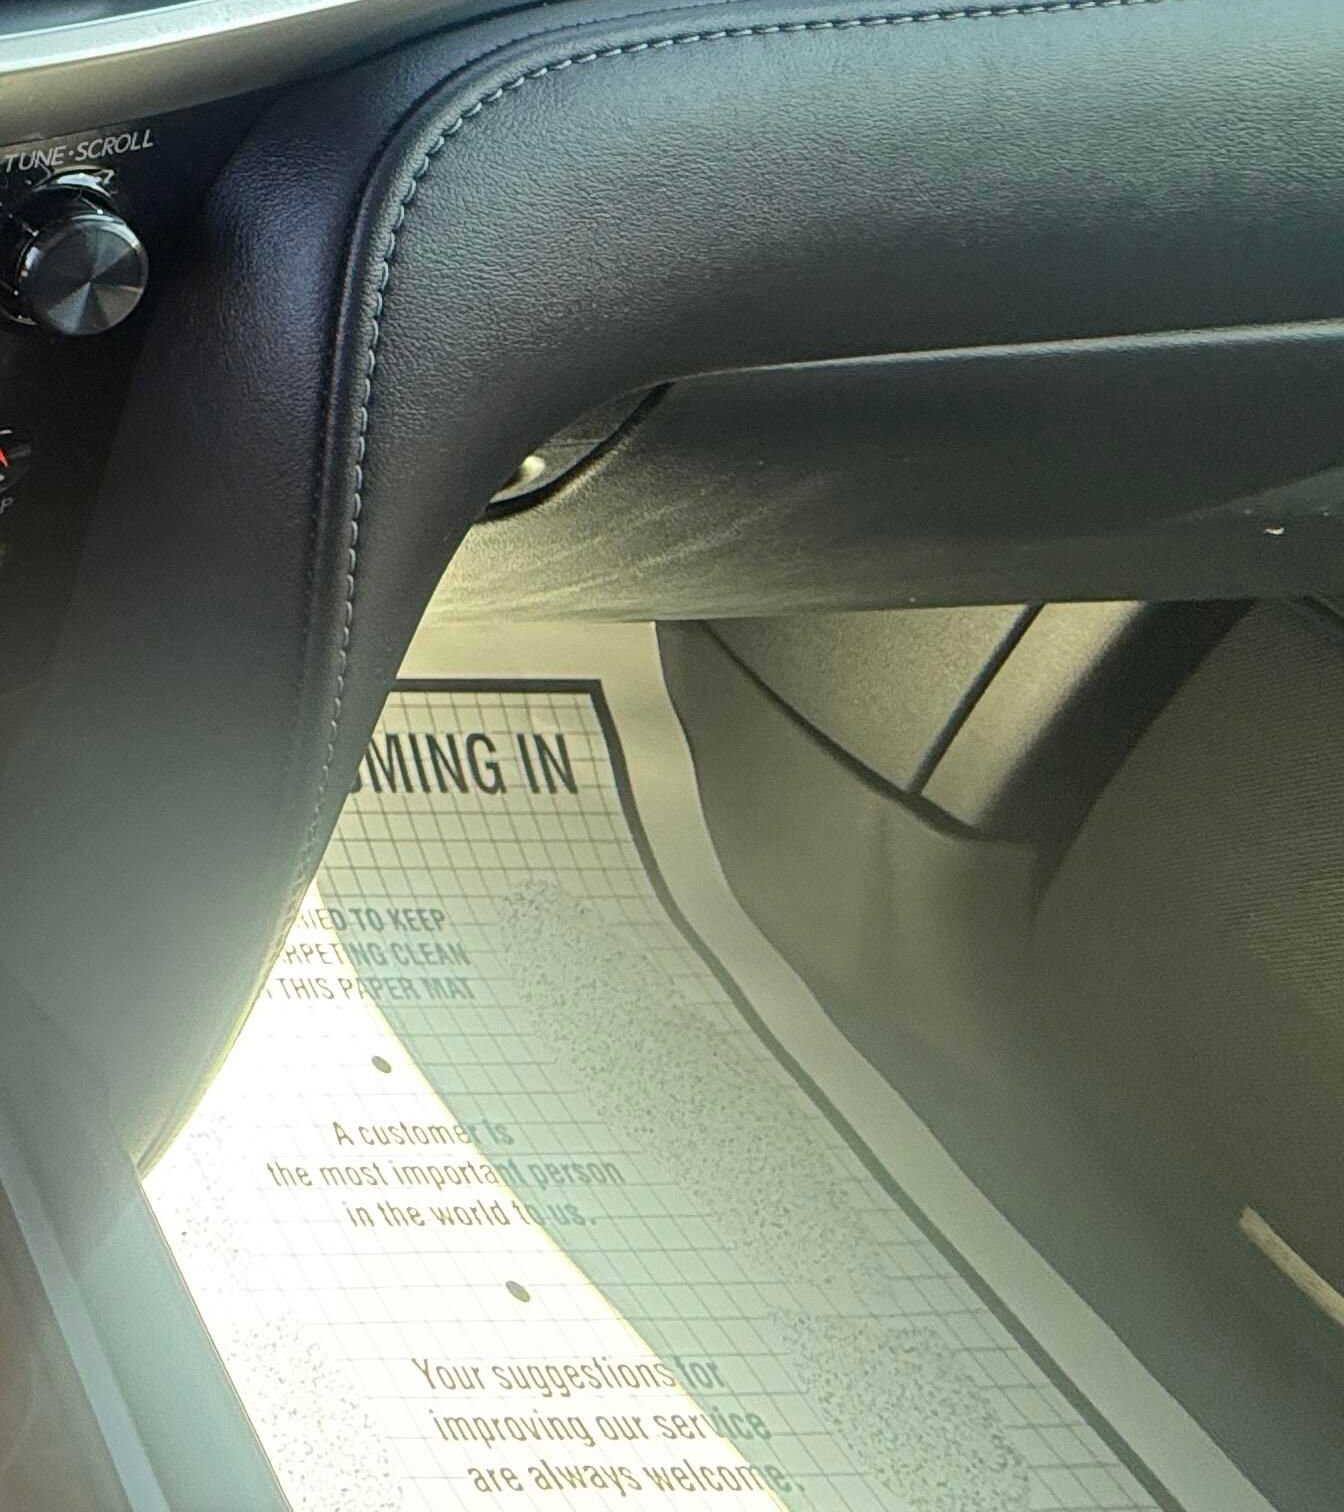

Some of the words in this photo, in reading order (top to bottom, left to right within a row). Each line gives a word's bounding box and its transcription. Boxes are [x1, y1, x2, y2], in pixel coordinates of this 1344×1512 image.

[517, 733, 579, 795] IN
[385, 907, 447, 933] KEEP
[392, 943, 472, 967] CLEAN
[276, 977, 335, 1001] THIS
[358, 1120, 481, 1146] customer
[266, 1161, 313, 1187] the
[319, 1161, 390, 1187] most
[387, 1159, 526, 1191] important
[527, 1160, 627, 1191] person
[376, 1200, 425, 1227] the
[428, 1200, 512, 1227] world
[411, 1356, 486, 1391] Your
[491, 1356, 676, 1398] suggestions
[428, 1408, 597, 1448] improving
[594, 1415, 650, 1441] our
[652, 1406, 773, 1441] service
[467, 1465, 525, 1493] are
[527, 1458, 643, 1498] always
[642, 1458, 805, 1494] welcome.
